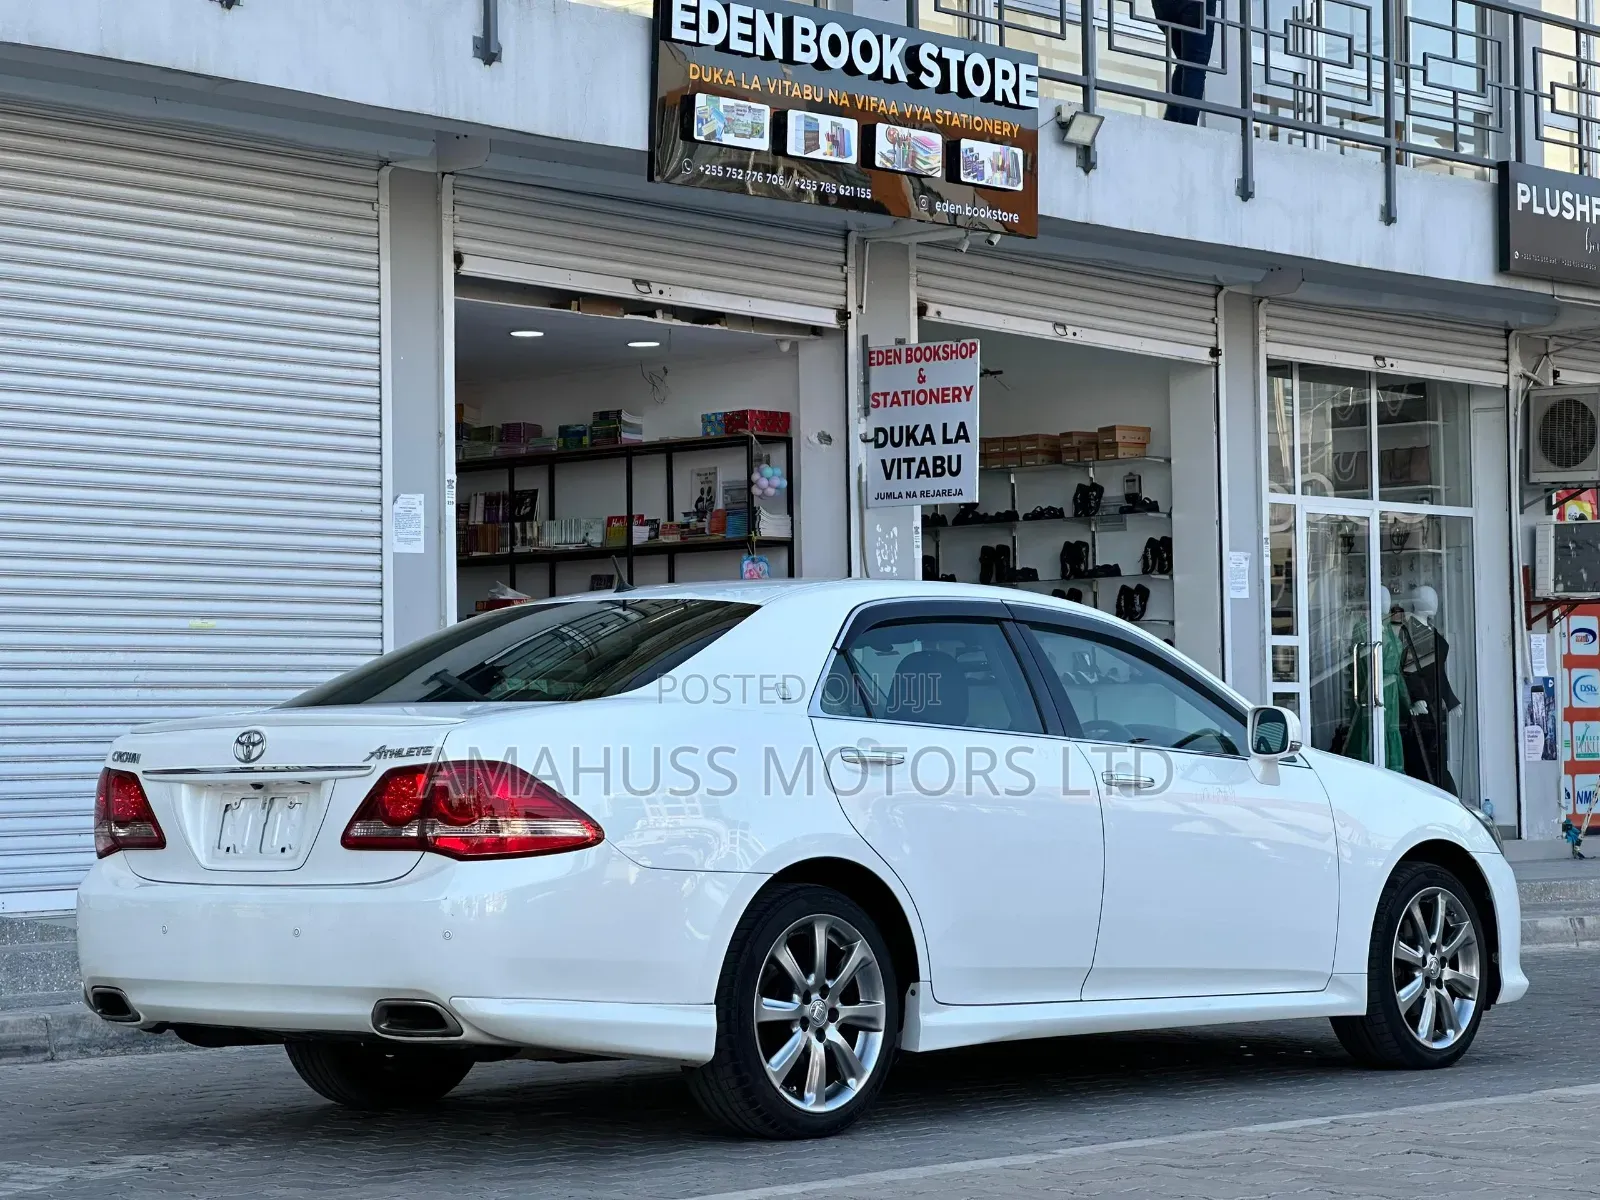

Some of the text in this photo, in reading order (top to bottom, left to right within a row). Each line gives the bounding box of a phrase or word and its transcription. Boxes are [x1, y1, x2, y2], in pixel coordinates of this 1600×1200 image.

[672, 0, 1039, 108] EDEN BOOK STORE
[689, 63, 1020, 138] DUKA LA VITABU NA VIFAA VYA STATIONERY
[699, 163, 723, 178] +255
[726, 166, 743, 180] 752
[746, 170, 763, 183] 776
[766, 173, 784, 185] 706
[795, 179, 817, 190] +255
[820, 181, 837, 194] 785
[839, 185, 855, 197] 621
[856, 186, 872, 199] 155
[935, 199, 1019, 223] eden.bookstore
[868, 342, 977, 367] EDEN BOOKSHOP
[917, 367, 926, 385] &
[870, 385, 974, 409] STATIONERY
[873, 421, 971, 449] DUKA LA
[880, 454, 962, 481] VITABU
[874, 488, 964, 501] JUMLA NA REJAREJA
[111, 750, 141, 765] CROWN
